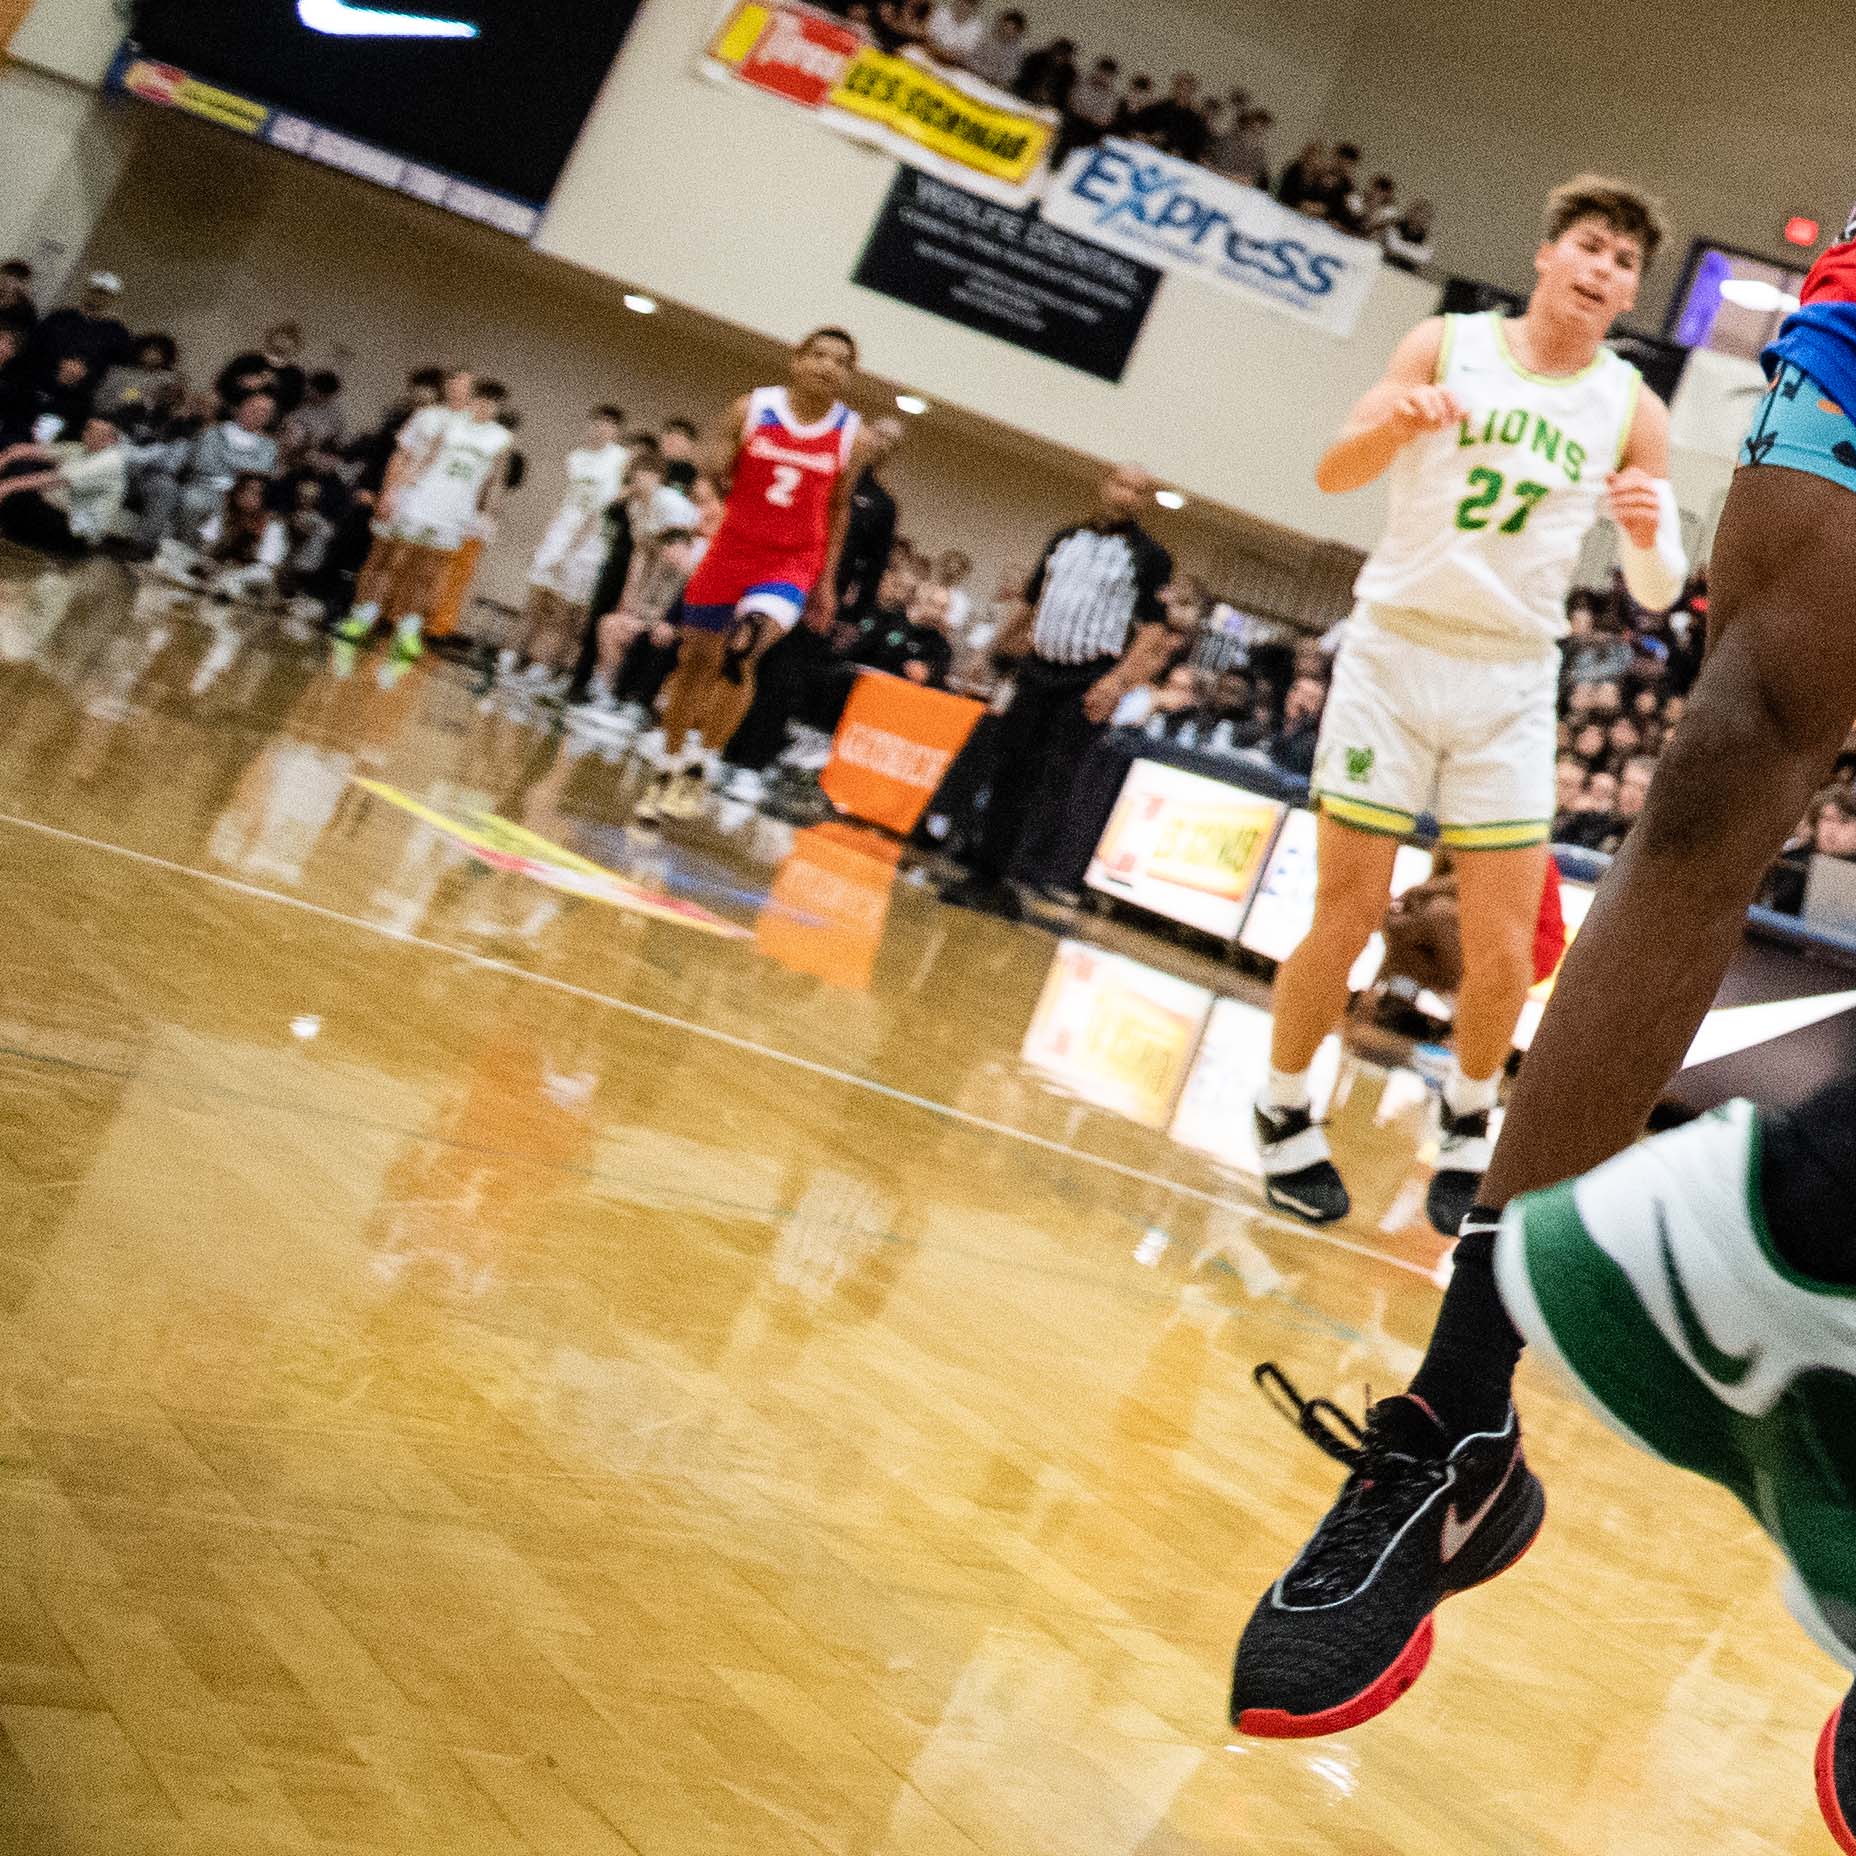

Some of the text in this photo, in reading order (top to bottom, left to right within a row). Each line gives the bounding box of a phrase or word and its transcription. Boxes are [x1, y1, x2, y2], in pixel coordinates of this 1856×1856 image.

[1072, 145, 1345, 295] Express
[1458, 409, 1587, 482] LIONS
[765, 465, 802, 508] 2
[1456, 465, 1549, 533] 27
